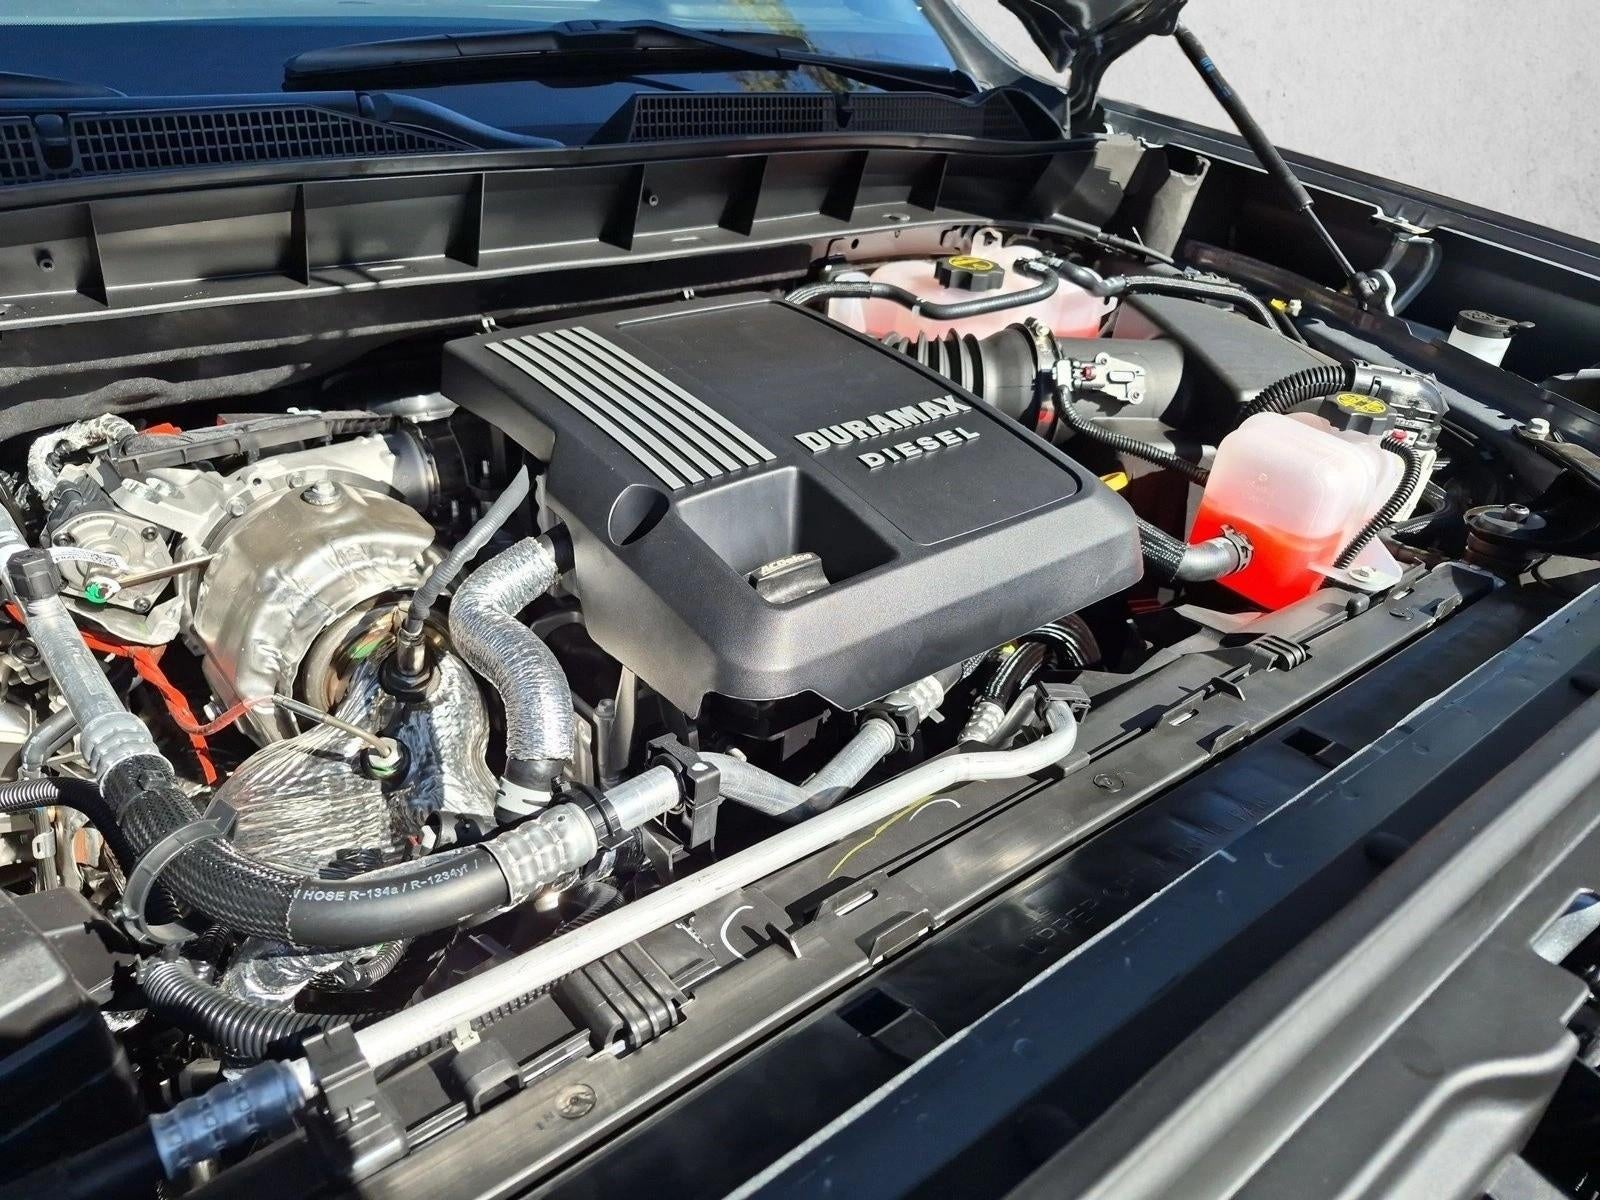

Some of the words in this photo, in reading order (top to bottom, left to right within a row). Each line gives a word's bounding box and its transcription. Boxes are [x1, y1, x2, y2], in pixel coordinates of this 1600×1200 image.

[794, 394, 972, 453] DURAMAX
[857, 426, 981, 469] DIESEL
[303, 889, 346, 902] HOSE
[348, 886, 399, 901] R-134a
[402, 882, 407, 893] /
